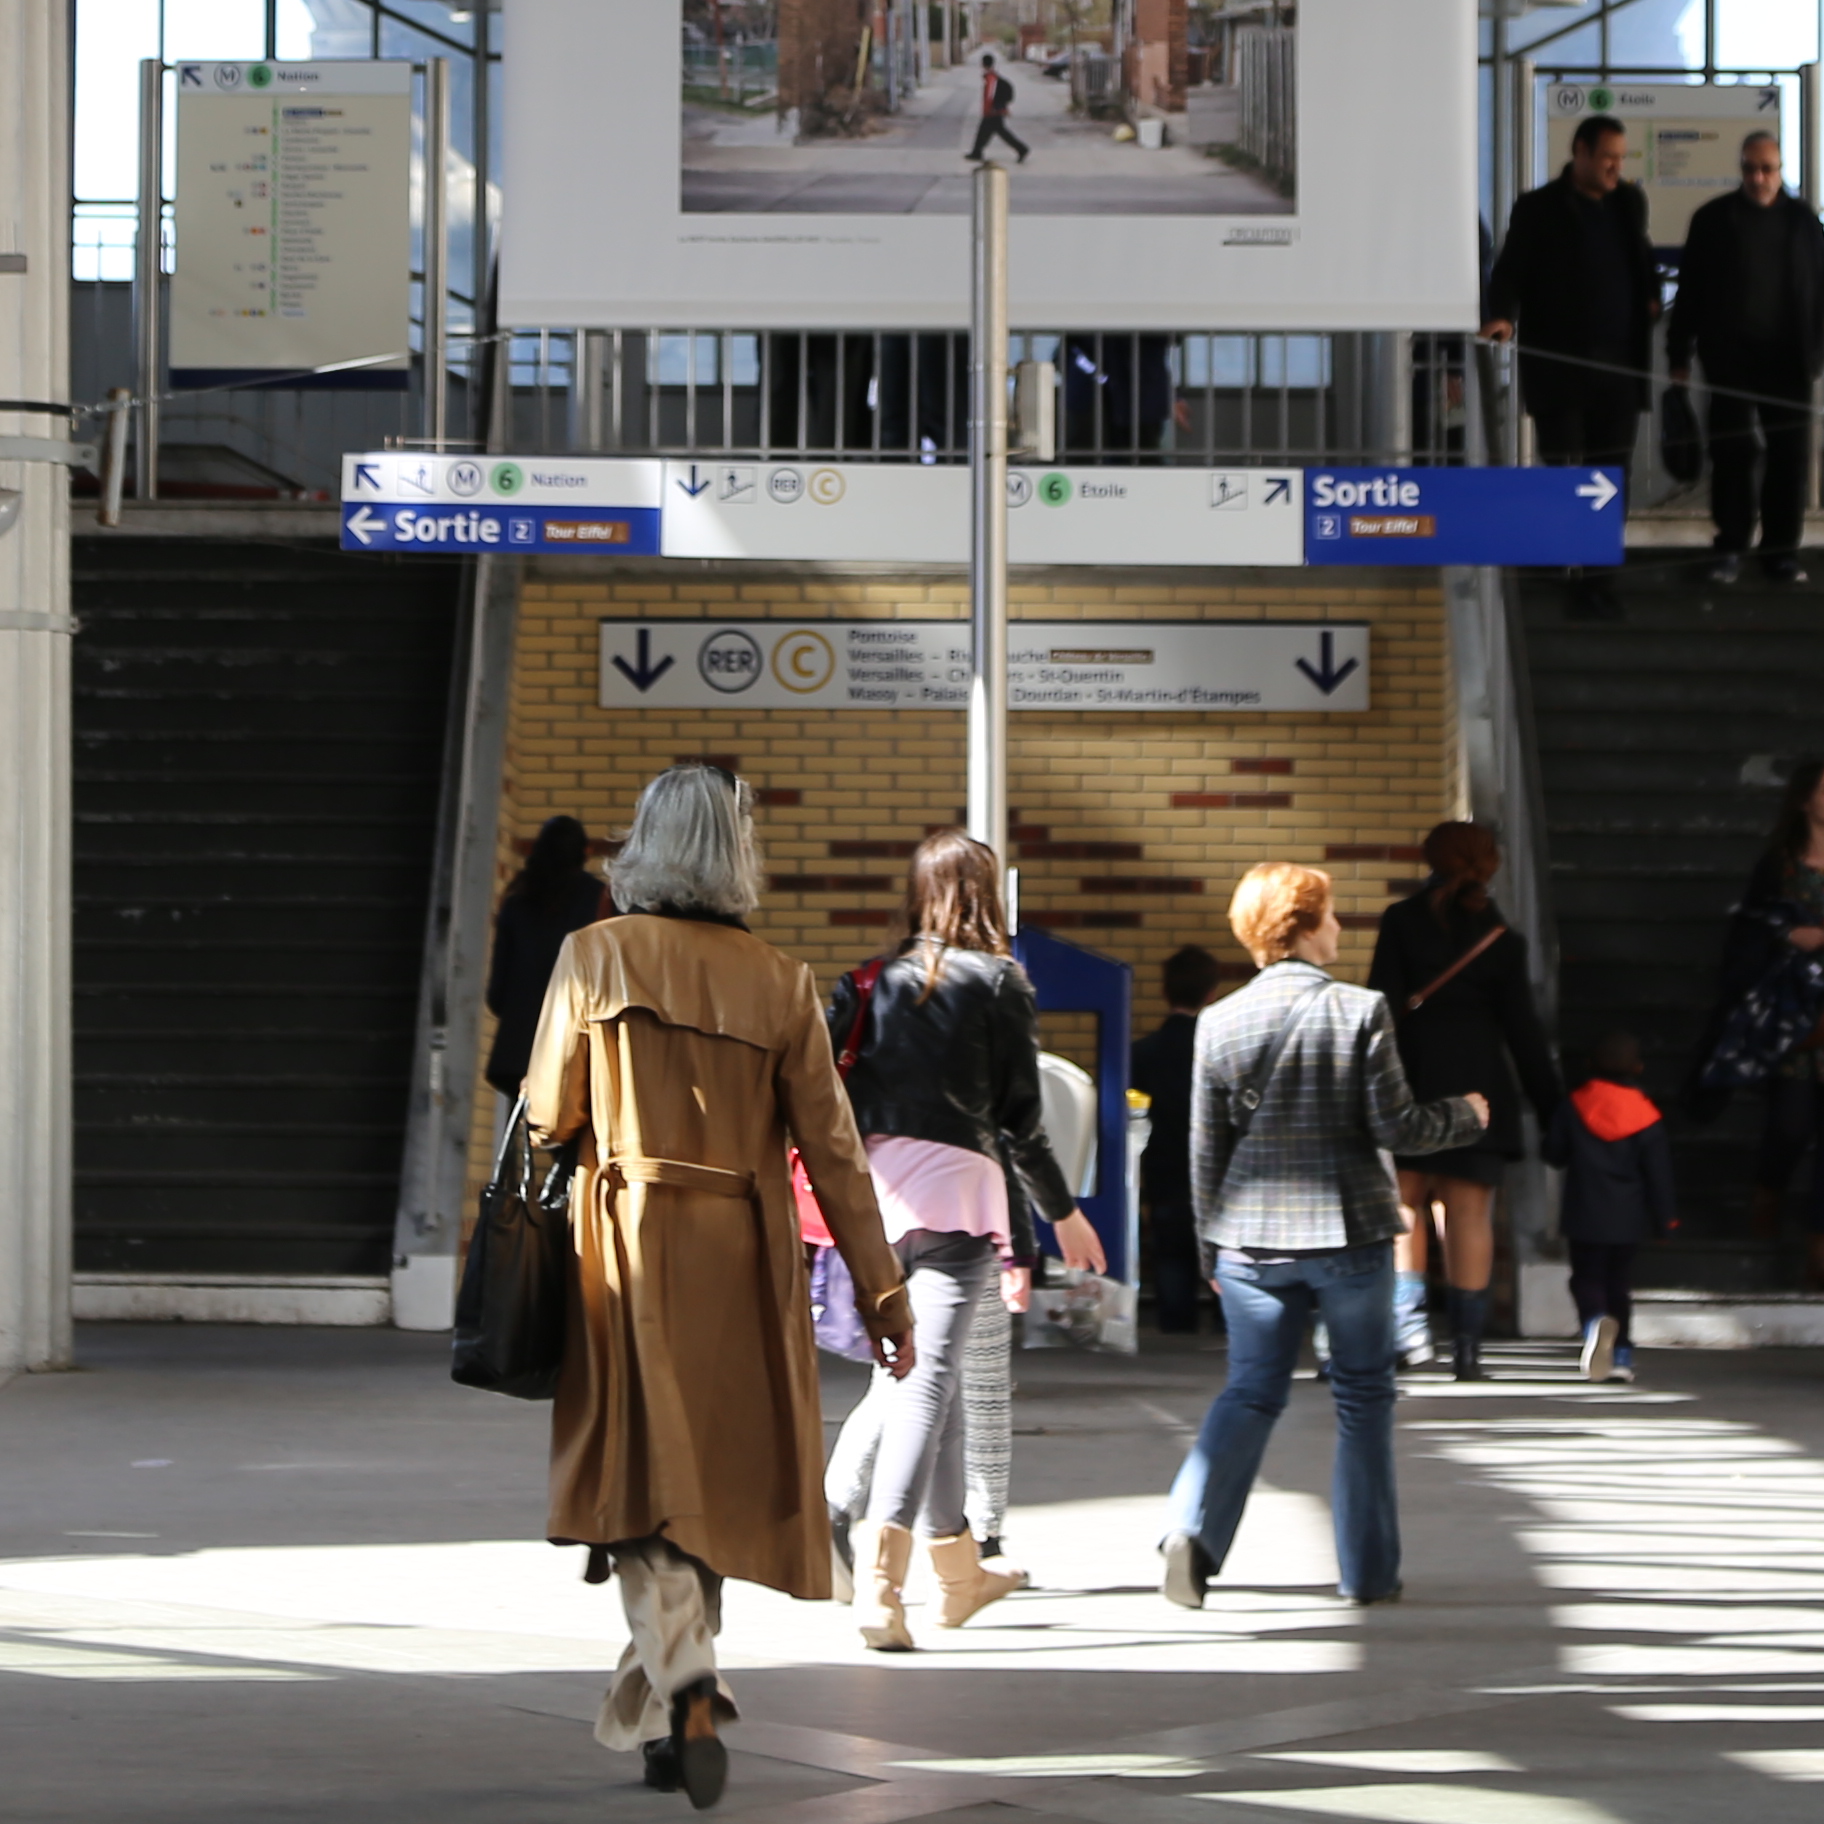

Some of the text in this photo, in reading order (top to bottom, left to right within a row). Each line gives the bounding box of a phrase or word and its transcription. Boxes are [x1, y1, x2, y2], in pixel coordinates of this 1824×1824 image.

[277, 71, 319, 82] Nation
[531, 473, 589, 488] Nation
[1080, 479, 1127, 499] Étoile
[1312, 474, 1421, 508] Sortie
[393, 509, 501, 545] Sortie
[545, 525, 575, 540] Tour
[577, 524, 613, 540] Eiffel
[1352, 520, 1382, 534] Tour
[1383, 520, 1419, 534] Eiffel
[848, 648, 925, 663] Versailles
[848, 667, 925, 682] Versailles
